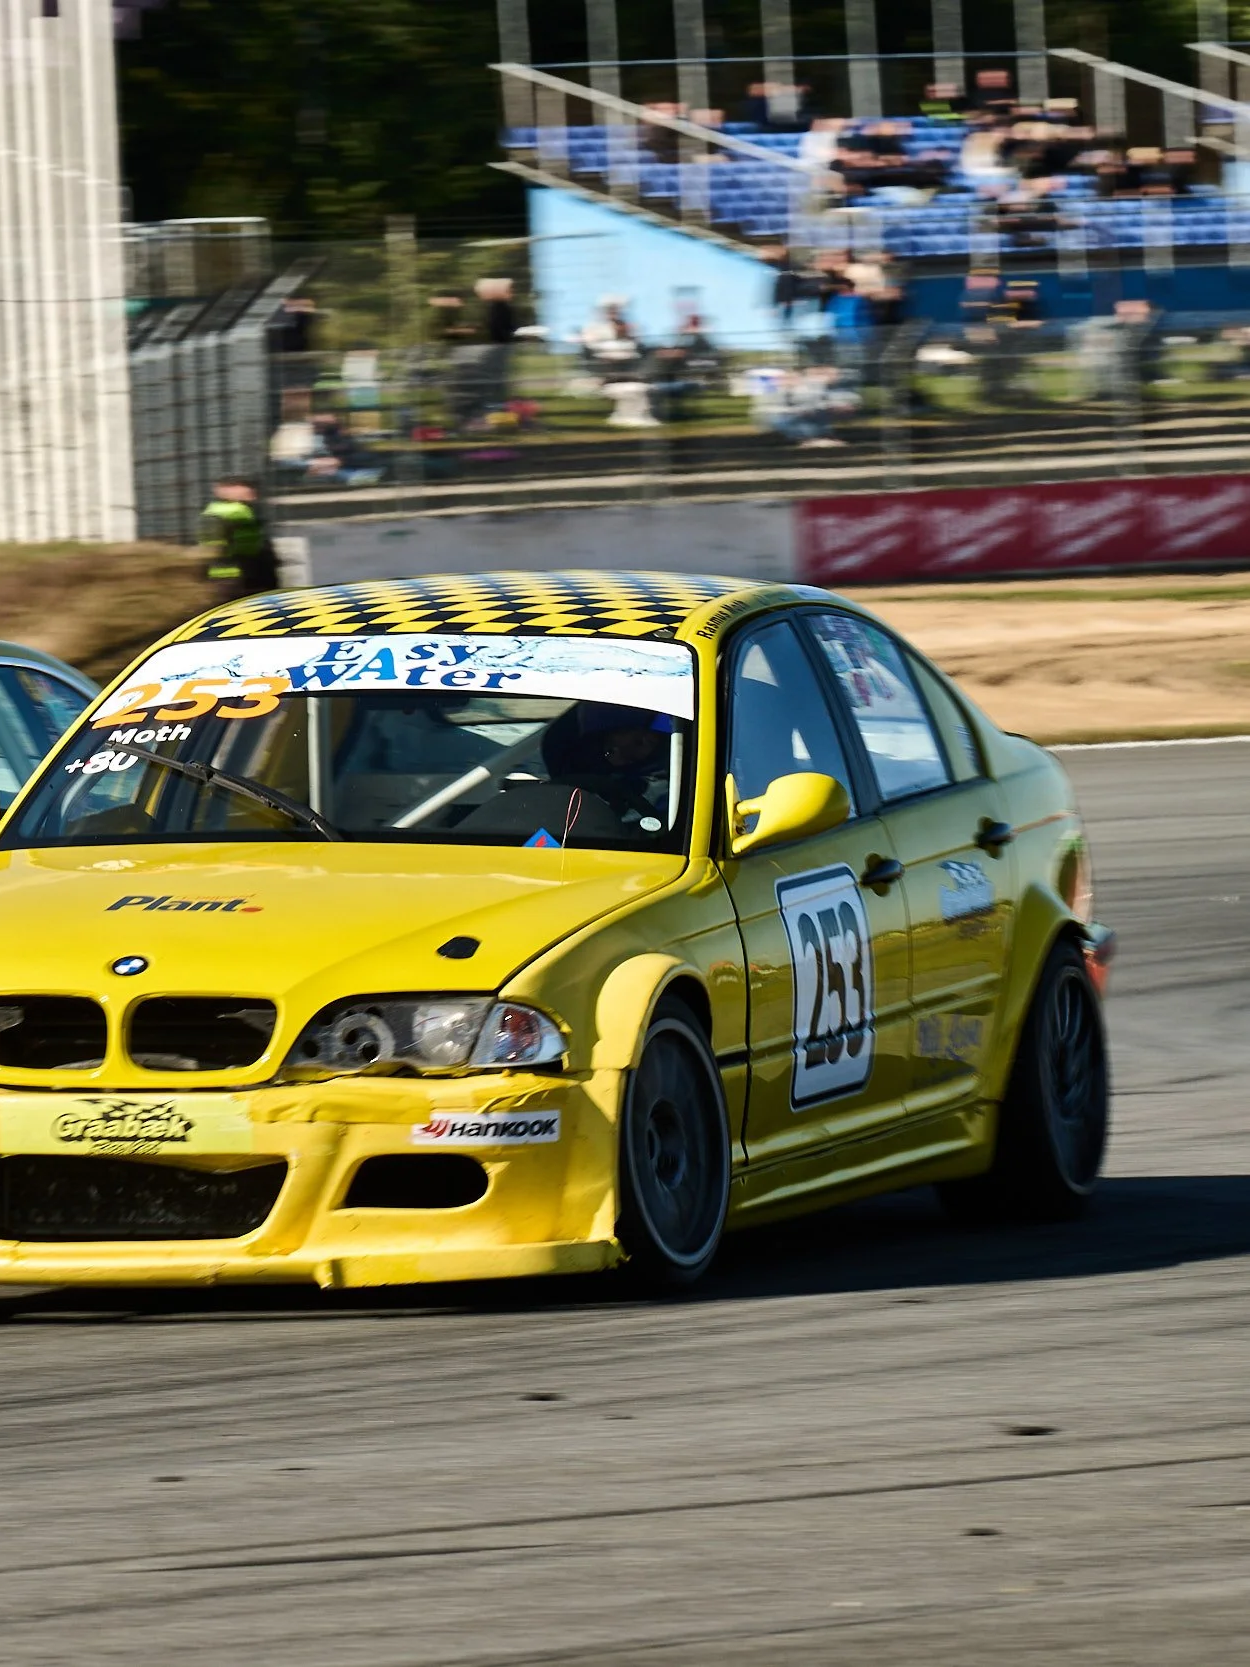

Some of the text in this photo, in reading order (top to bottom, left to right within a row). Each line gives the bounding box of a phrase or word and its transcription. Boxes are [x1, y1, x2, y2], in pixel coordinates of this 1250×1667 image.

[696, 609, 731, 640] Rasmus
[91, 676, 292, 730] 253
[107, 723, 192, 745] Moth
[798, 901, 866, 1071] 253
